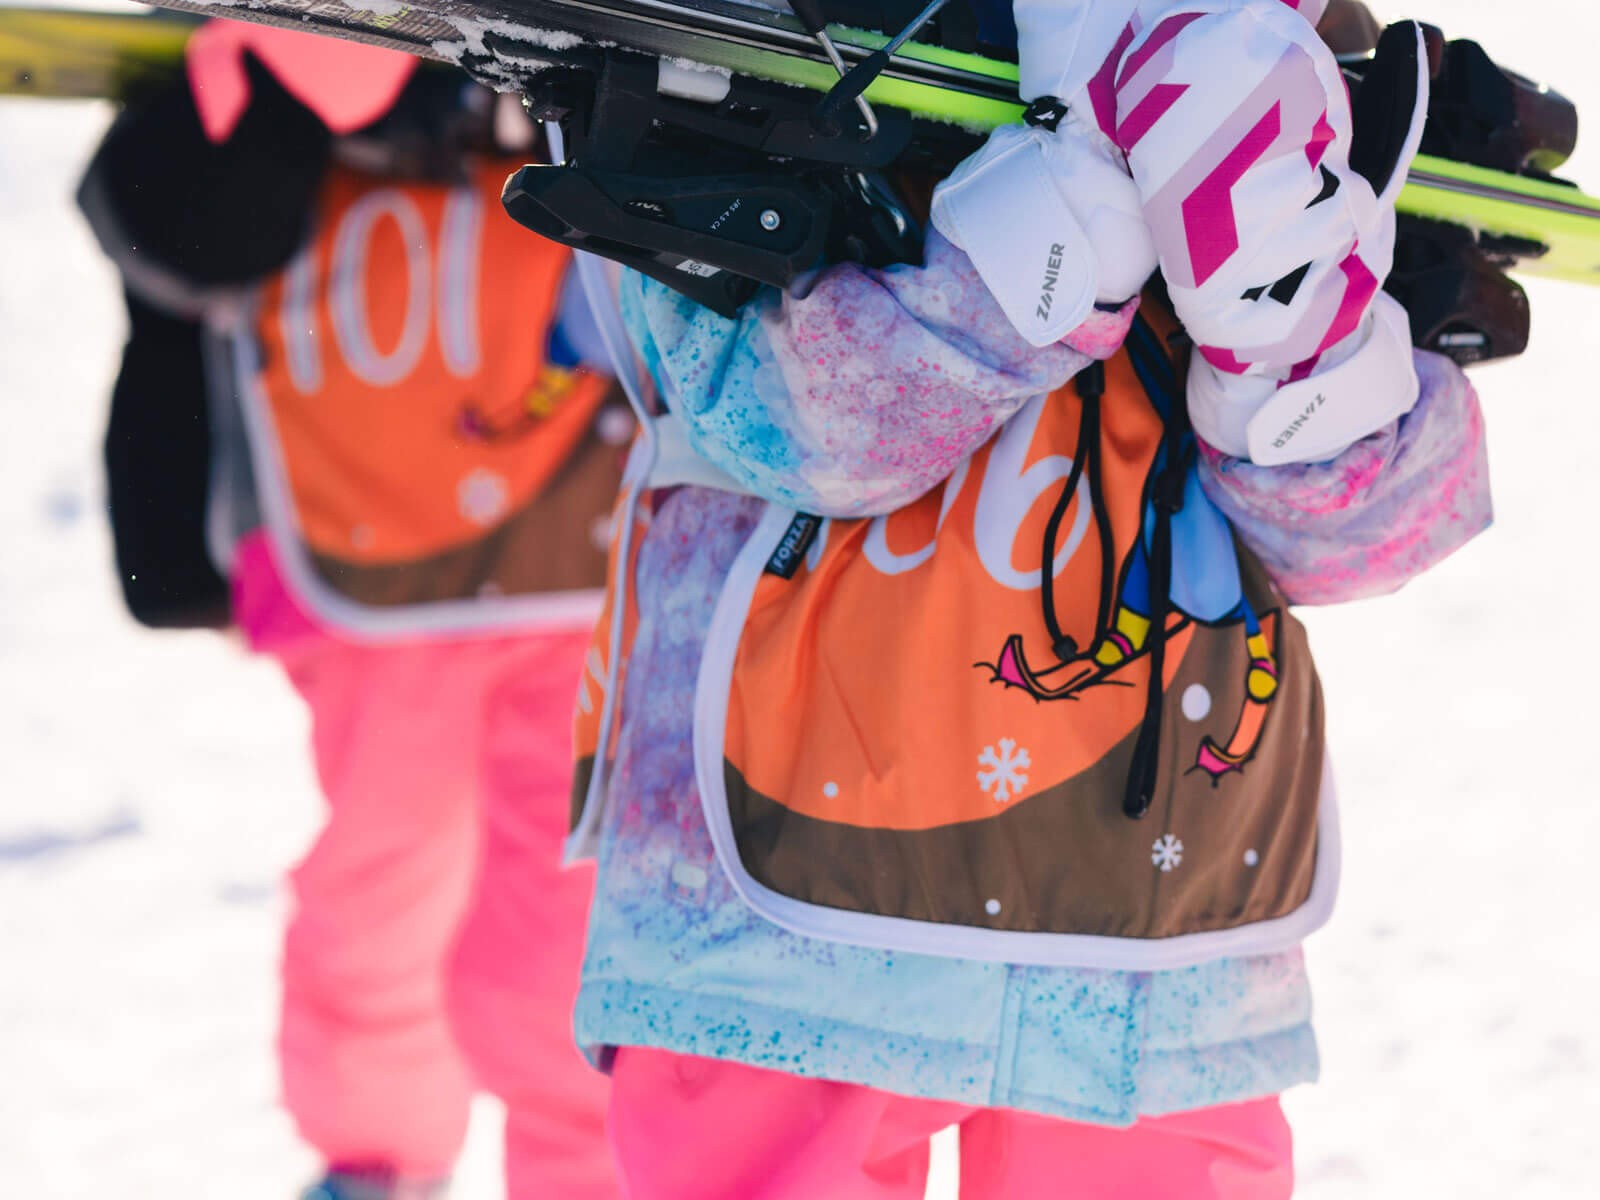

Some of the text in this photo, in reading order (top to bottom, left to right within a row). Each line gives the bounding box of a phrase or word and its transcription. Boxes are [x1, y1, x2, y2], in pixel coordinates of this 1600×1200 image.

[1036, 243, 1065, 321] ZANIER
[1272, 393, 1326, 448] ZANIER
[772, 519, 808, 569] FORZA
